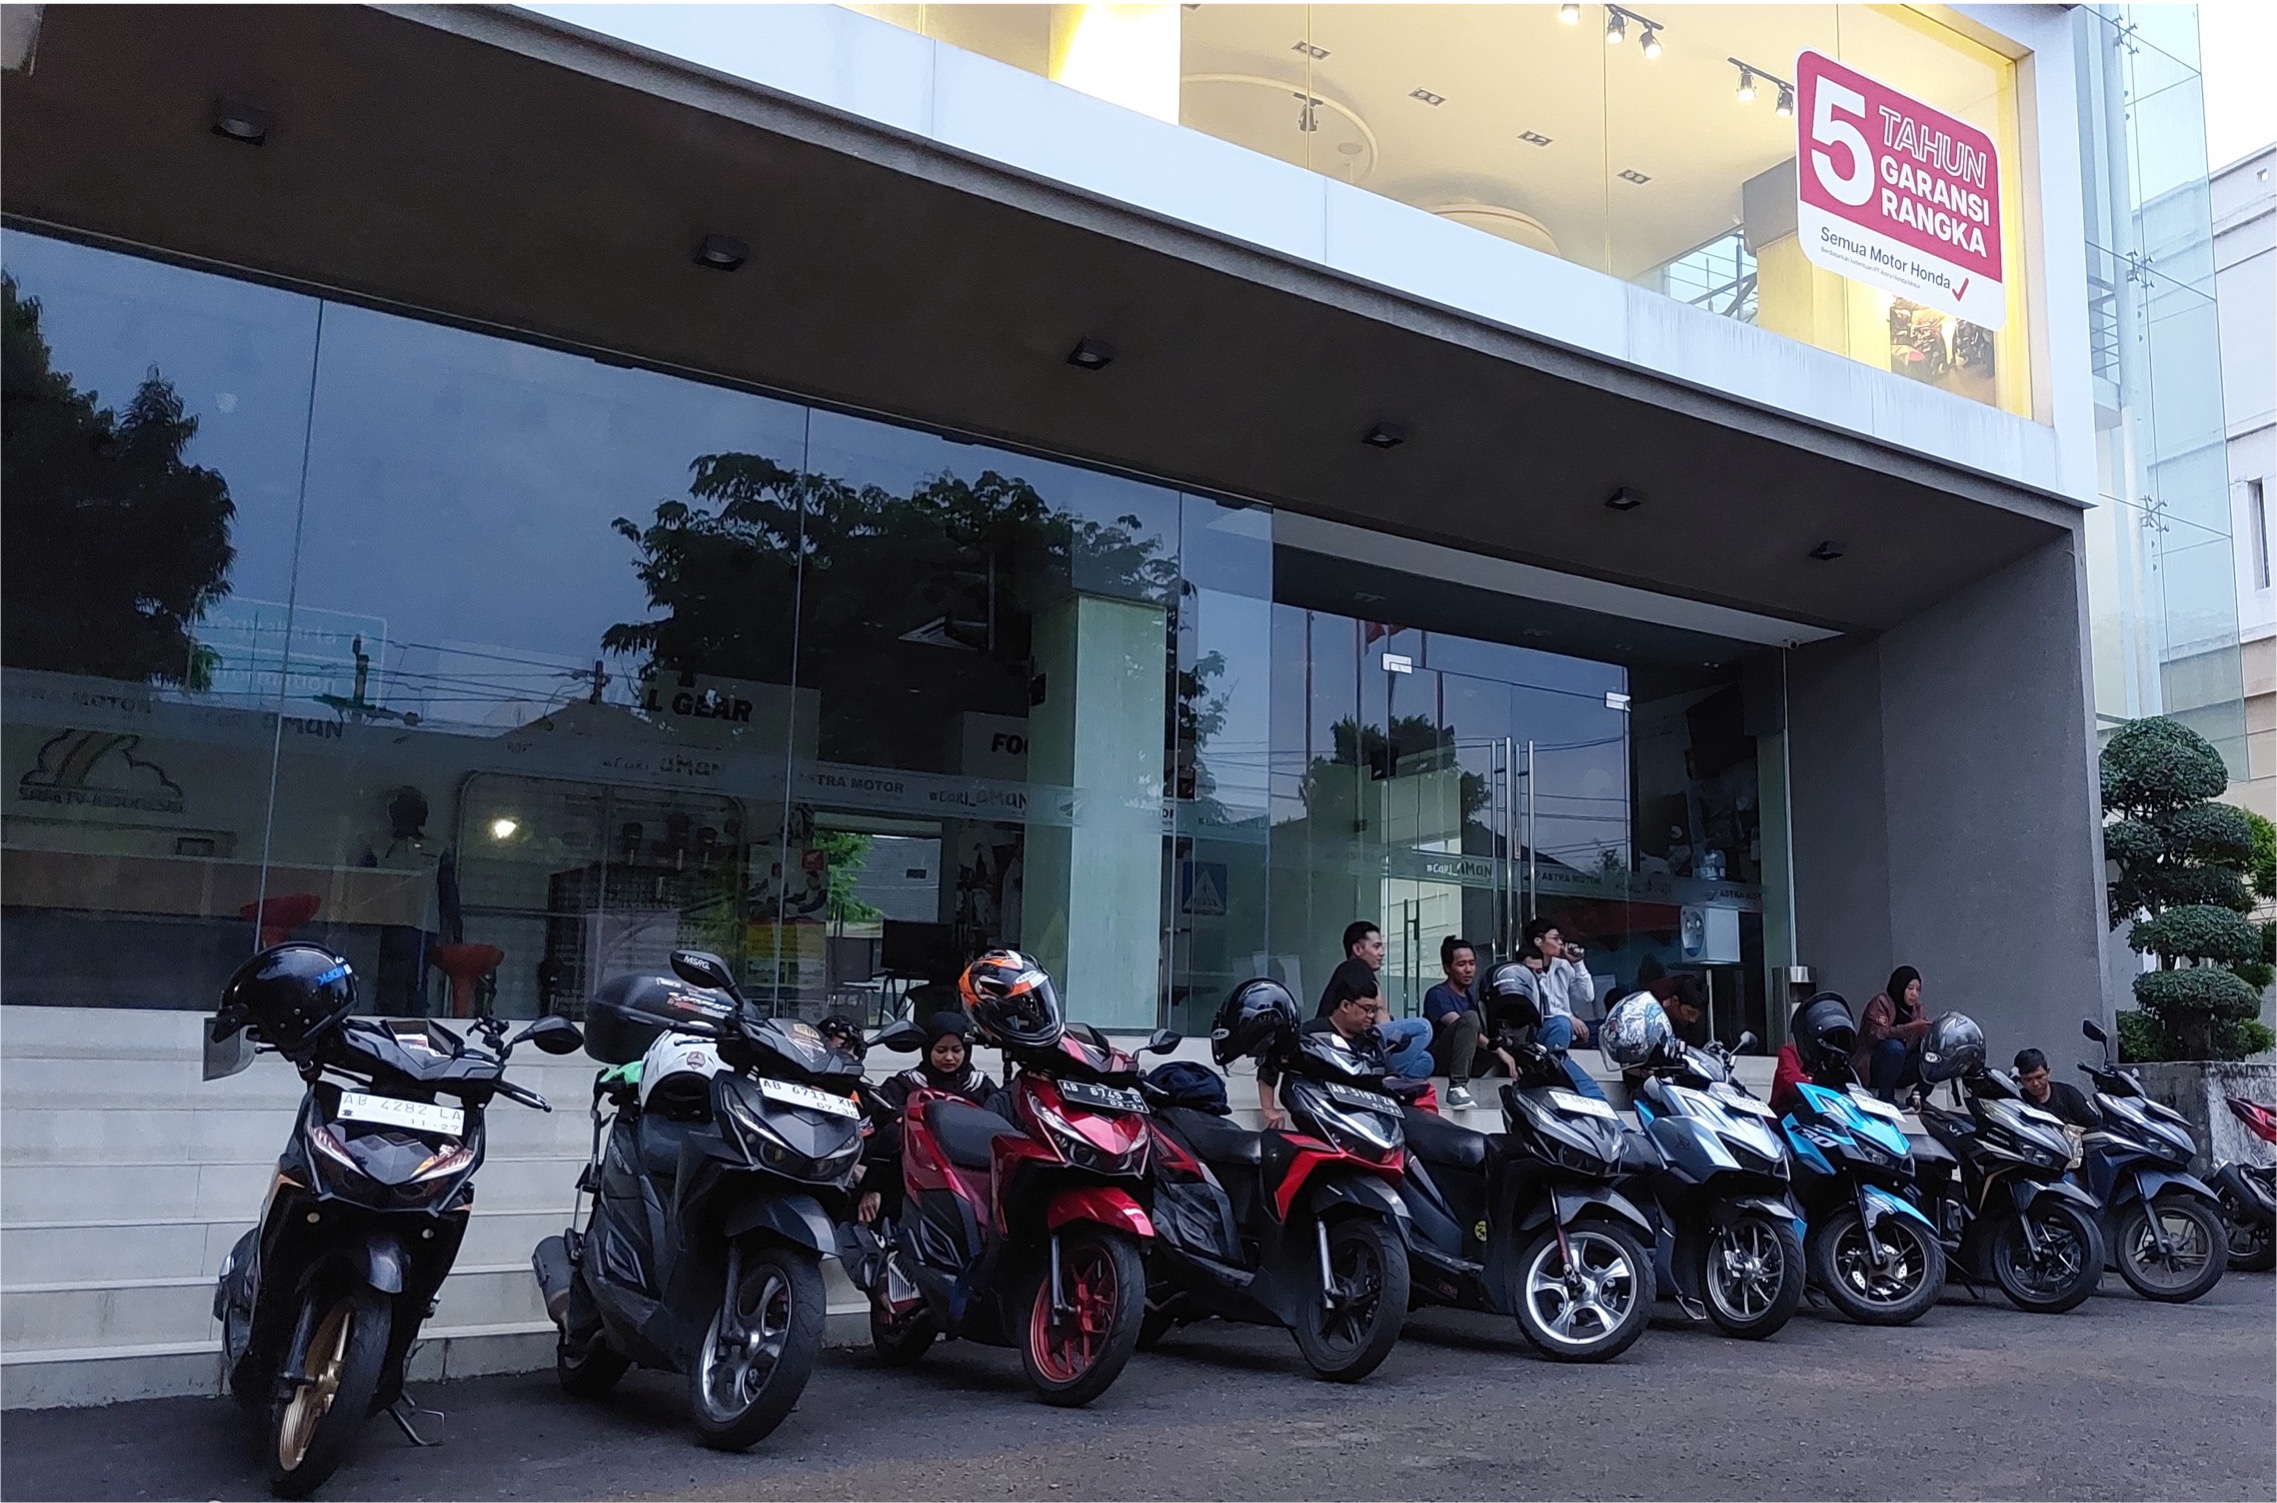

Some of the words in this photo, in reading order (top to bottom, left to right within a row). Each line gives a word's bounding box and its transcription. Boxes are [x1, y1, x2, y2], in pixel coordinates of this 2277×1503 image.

[1811, 75, 1875, 207] 5
[1878, 105, 1987, 189] TAHUN
[1880, 155, 1990, 227] GARANSI
[1881, 187, 1987, 258] RANGKA
[1821, 226, 1866, 257] Semua
[1870, 246, 1908, 272] Motor
[1911, 261, 1951, 289] Honda
[672, 692, 753, 722] GEAR
[851, 777, 904, 793] MOTOR
[1541, 872, 1570, 883] ASTRA
[1572, 874, 1601, 885] MOTOR
[763, 1080, 781, 1091] AB
[1062, 1081, 1079, 1093] AB
[1331, 1084, 1347, 1095] AB
[343, 1094, 368, 1106] AB
[381, 1100, 428, 1116] 4282
[439, 1108, 462, 1121] LA
[1986, 1131, 2011, 1147] HONDA
